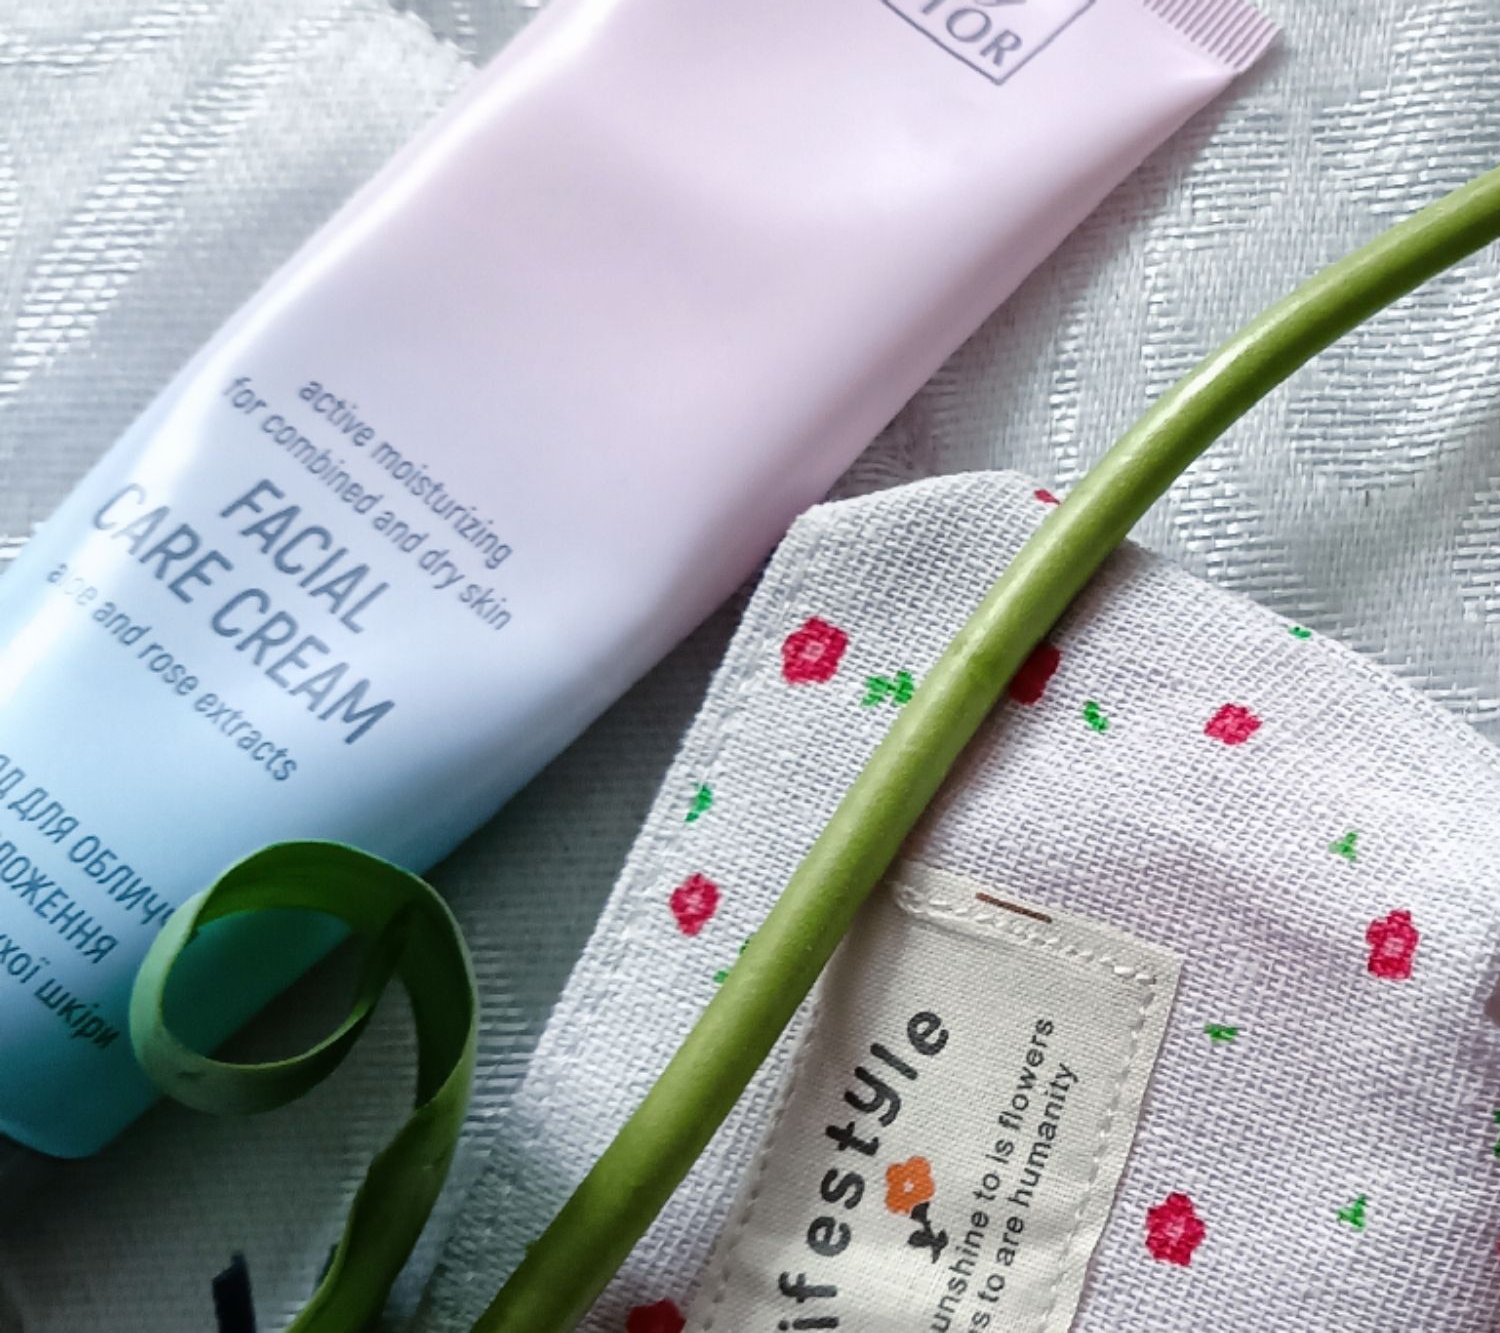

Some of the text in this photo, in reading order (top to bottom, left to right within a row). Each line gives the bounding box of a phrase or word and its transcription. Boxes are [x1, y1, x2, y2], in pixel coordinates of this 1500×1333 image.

[223, 376, 513, 631] for combined and dry skin
[298, 379, 514, 570] active moisturizing
[92, 482, 397, 745] CARE CREAM
[219, 479, 390, 634] FACIAL
[92, 600, 153, 647] and
[138, 640, 200, 697] rose
[193, 692, 299, 783] extracts
[7, 787, 80, 843] ДЛЯ
[999, 1019, 1054, 1131] flowers
[1007, 1063, 1079, 1208] humanity
[972, 1173, 1001, 1202] to
[986, 1139, 1014, 1166] is
[979, 1274, 1006, 1305] to
[998, 1217, 1025, 1268] are
